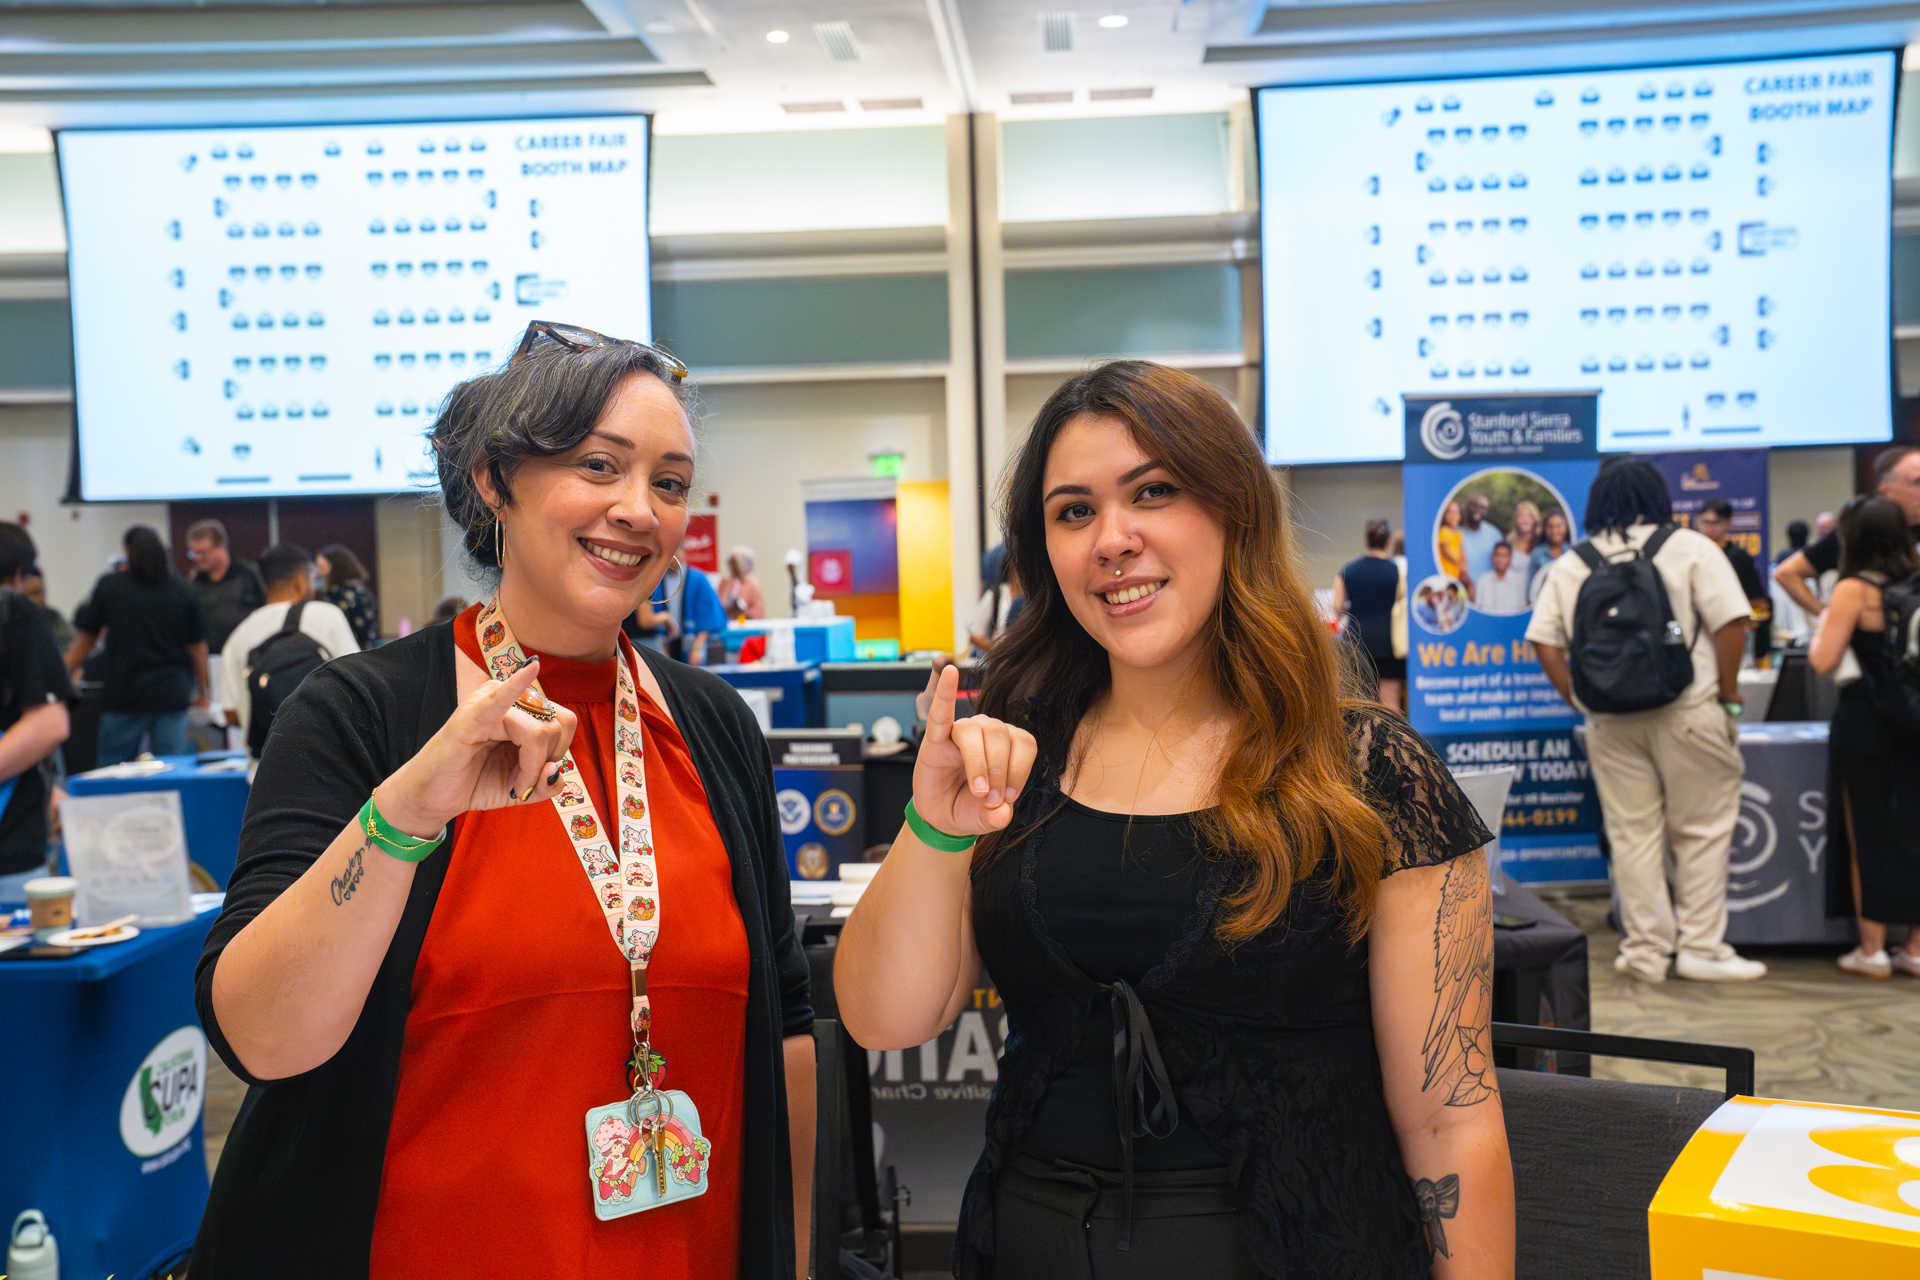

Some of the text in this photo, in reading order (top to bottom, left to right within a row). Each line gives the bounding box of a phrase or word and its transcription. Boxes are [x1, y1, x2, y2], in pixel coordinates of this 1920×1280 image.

[1744, 69, 1873, 95] CAREER FAIR
[1749, 98, 1873, 122] BOOTH MAP
[515, 131, 627, 151] CAREER FAIR
[521, 158, 627, 177] BOOTH MAP
[1468, 411, 1571, 429] Stanford Sierra
[1469, 427, 1584, 445] Youth & Families
[1418, 642, 1458, 668] We
[1462, 640, 1506, 666] Are
[1462, 674, 1487, 690] part
[1488, 672, 1502, 687] of
[1446, 738, 1571, 763] SCHEDULE AN
[1527, 760, 1590, 782] TODAY
[146, 1063, 198, 1120] CUPA
